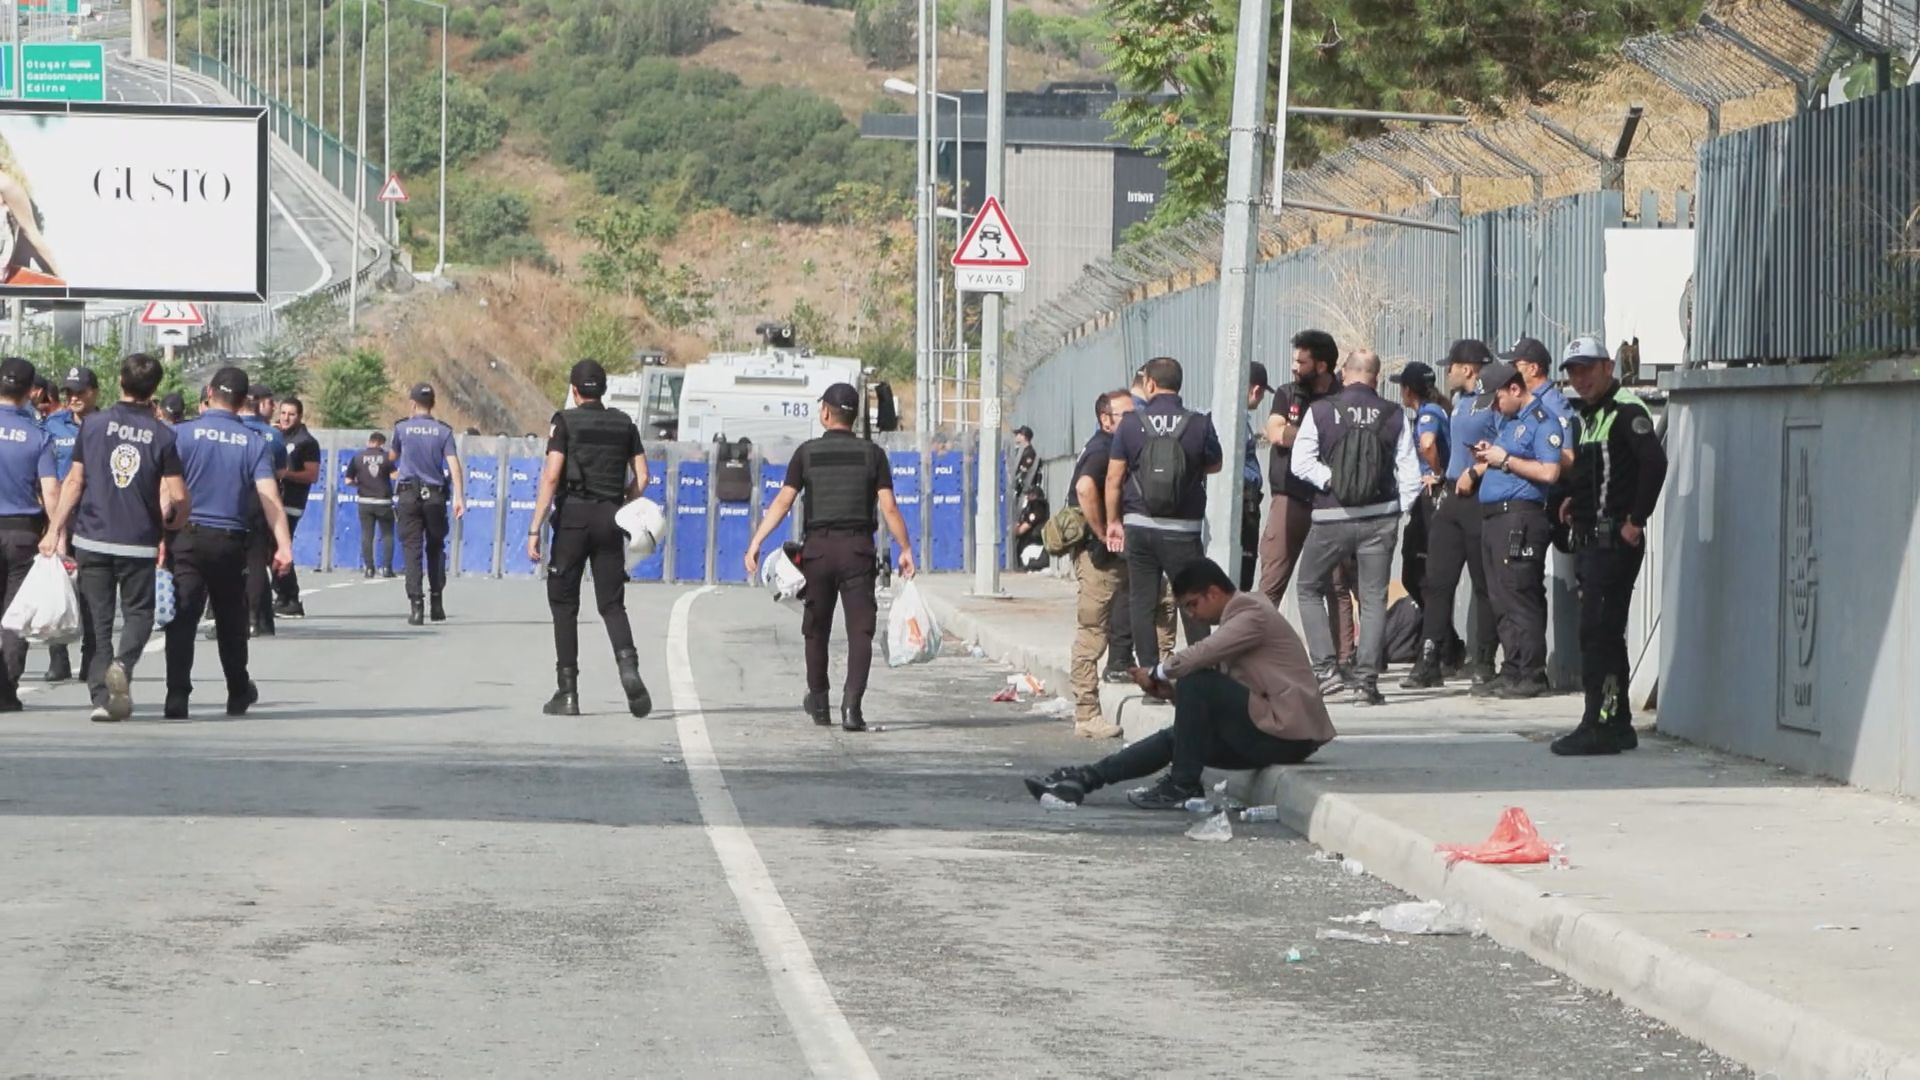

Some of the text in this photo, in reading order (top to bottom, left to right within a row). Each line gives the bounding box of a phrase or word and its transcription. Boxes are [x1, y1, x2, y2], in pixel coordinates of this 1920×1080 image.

[26, 83, 66, 92] Edirne
[93, 167, 231, 202] GUSTO
[967, 273, 1014, 286] YAVAŞ
[782, 402, 809, 417] T-83
